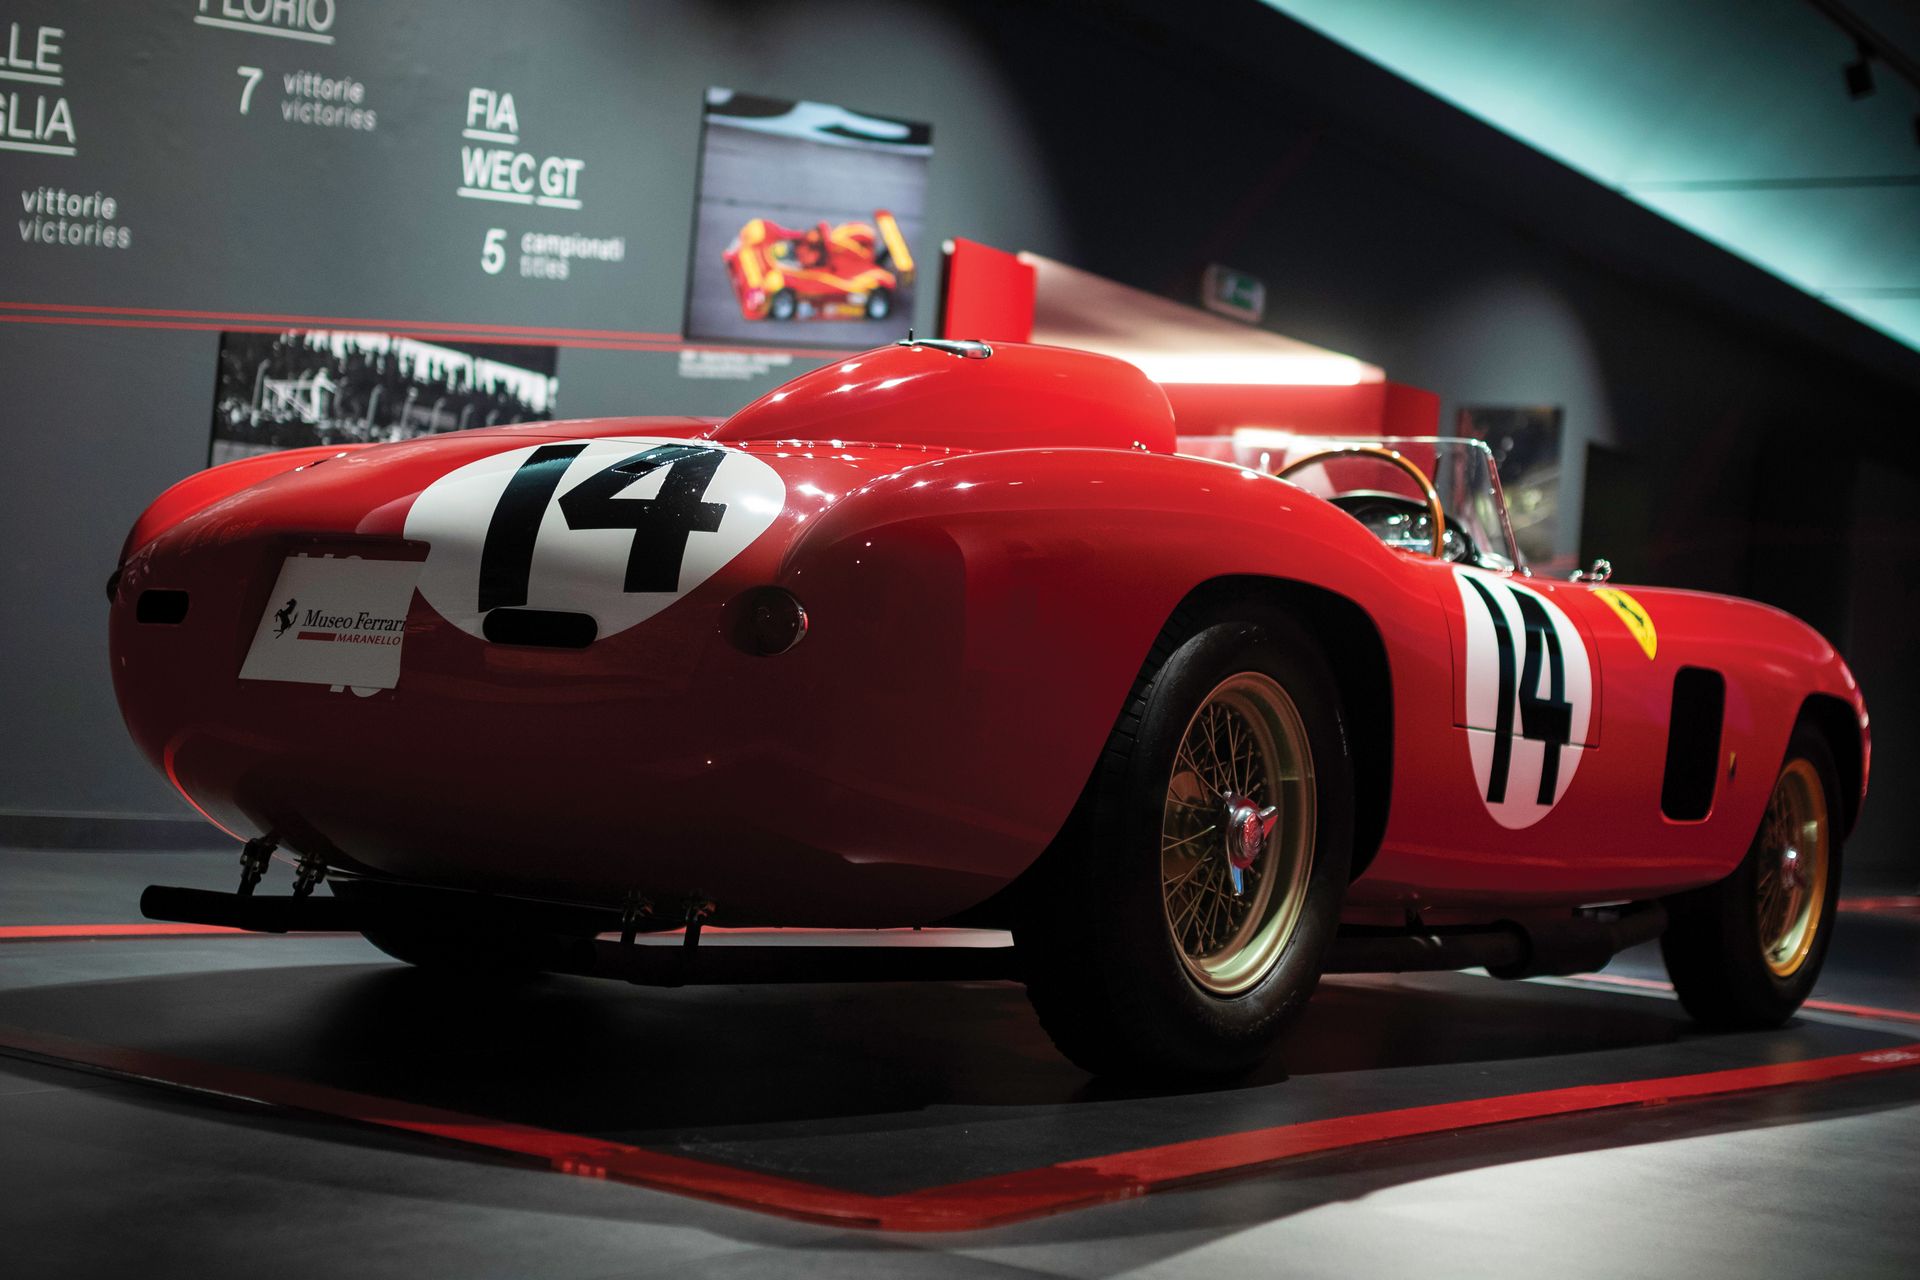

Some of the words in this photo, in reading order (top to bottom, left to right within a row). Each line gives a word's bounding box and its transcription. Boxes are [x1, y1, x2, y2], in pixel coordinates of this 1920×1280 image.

[0, 22, 65, 73] LE
[237, 65, 263, 115] 7
[283, 70, 365, 104] vittorie
[467, 87, 519, 133] FIA
[0, 92, 76, 143] LIA
[281, 98, 378, 132] victories
[461, 146, 537, 193] WEC
[539, 155, 586, 198] GT
[21, 186, 117, 220] vittorie
[18, 214, 132, 249] victories
[481, 228, 507, 275] 5
[478, 443, 729, 613] 14
[302, 609, 353, 629] Museo
[336, 633, 401, 646] MARANELLO
[1458, 572, 1574, 807] 14
